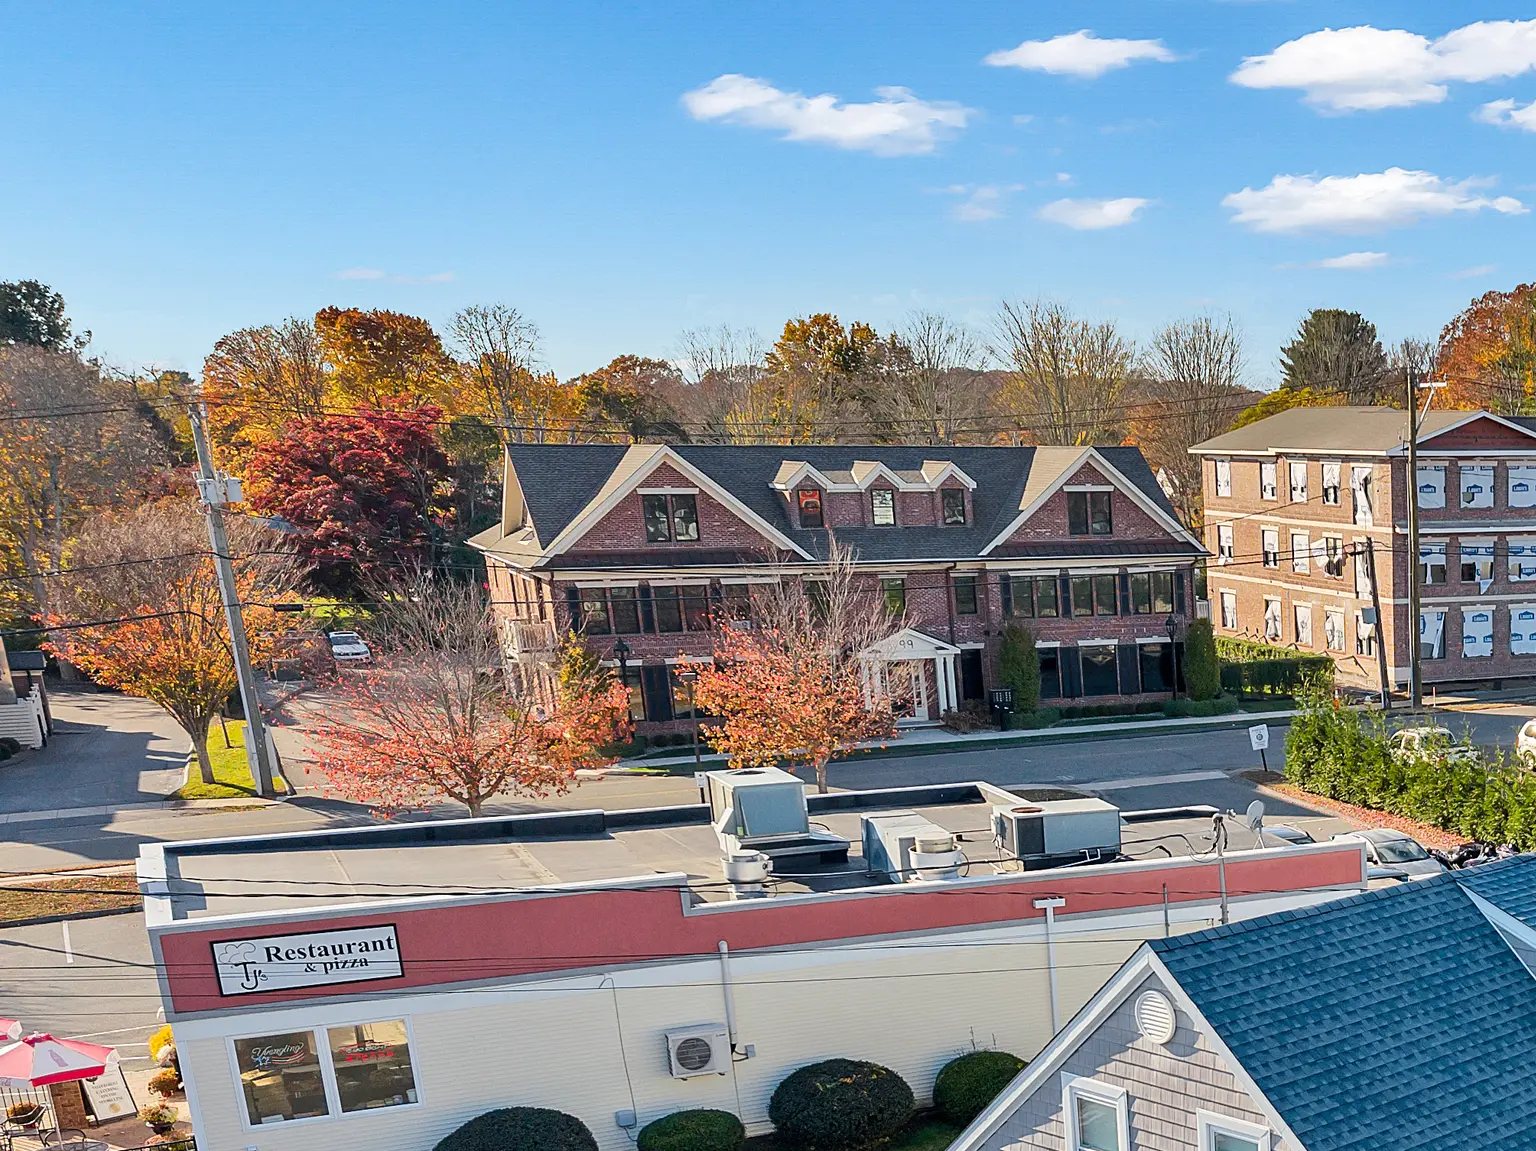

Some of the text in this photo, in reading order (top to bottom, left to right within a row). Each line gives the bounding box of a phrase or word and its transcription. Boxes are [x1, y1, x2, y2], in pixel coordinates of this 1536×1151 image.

[899, 639, 914, 649] 99
[264, 935, 395, 963] Restaurant
[304, 956, 369, 975] & pizza
